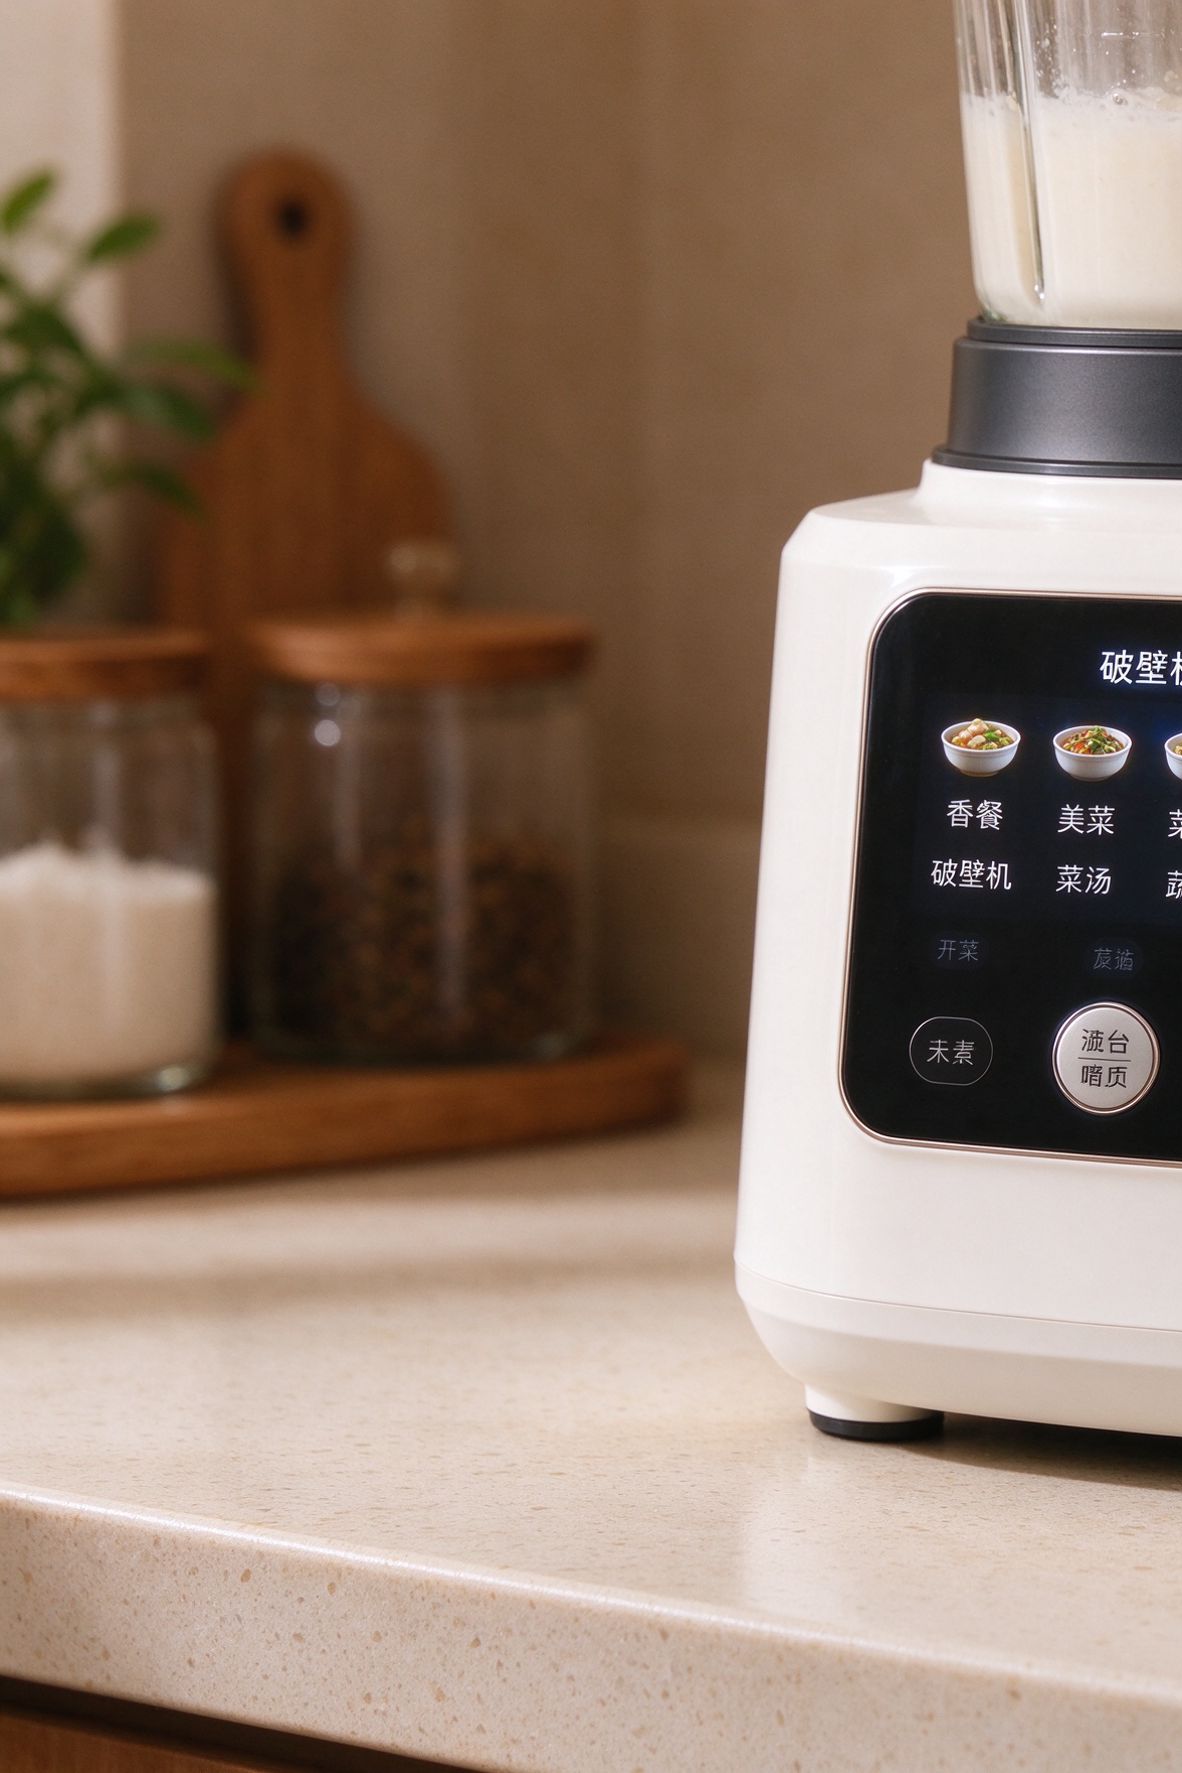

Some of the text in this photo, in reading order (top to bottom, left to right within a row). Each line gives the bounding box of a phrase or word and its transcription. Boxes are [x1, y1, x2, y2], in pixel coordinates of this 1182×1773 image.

[946, 799, 1003, 831] 香餐
[1057, 804, 1115, 835] 美菜
[930, 858, 1012, 890] 破壁机
[1055, 864, 1112, 895] 菜汤
